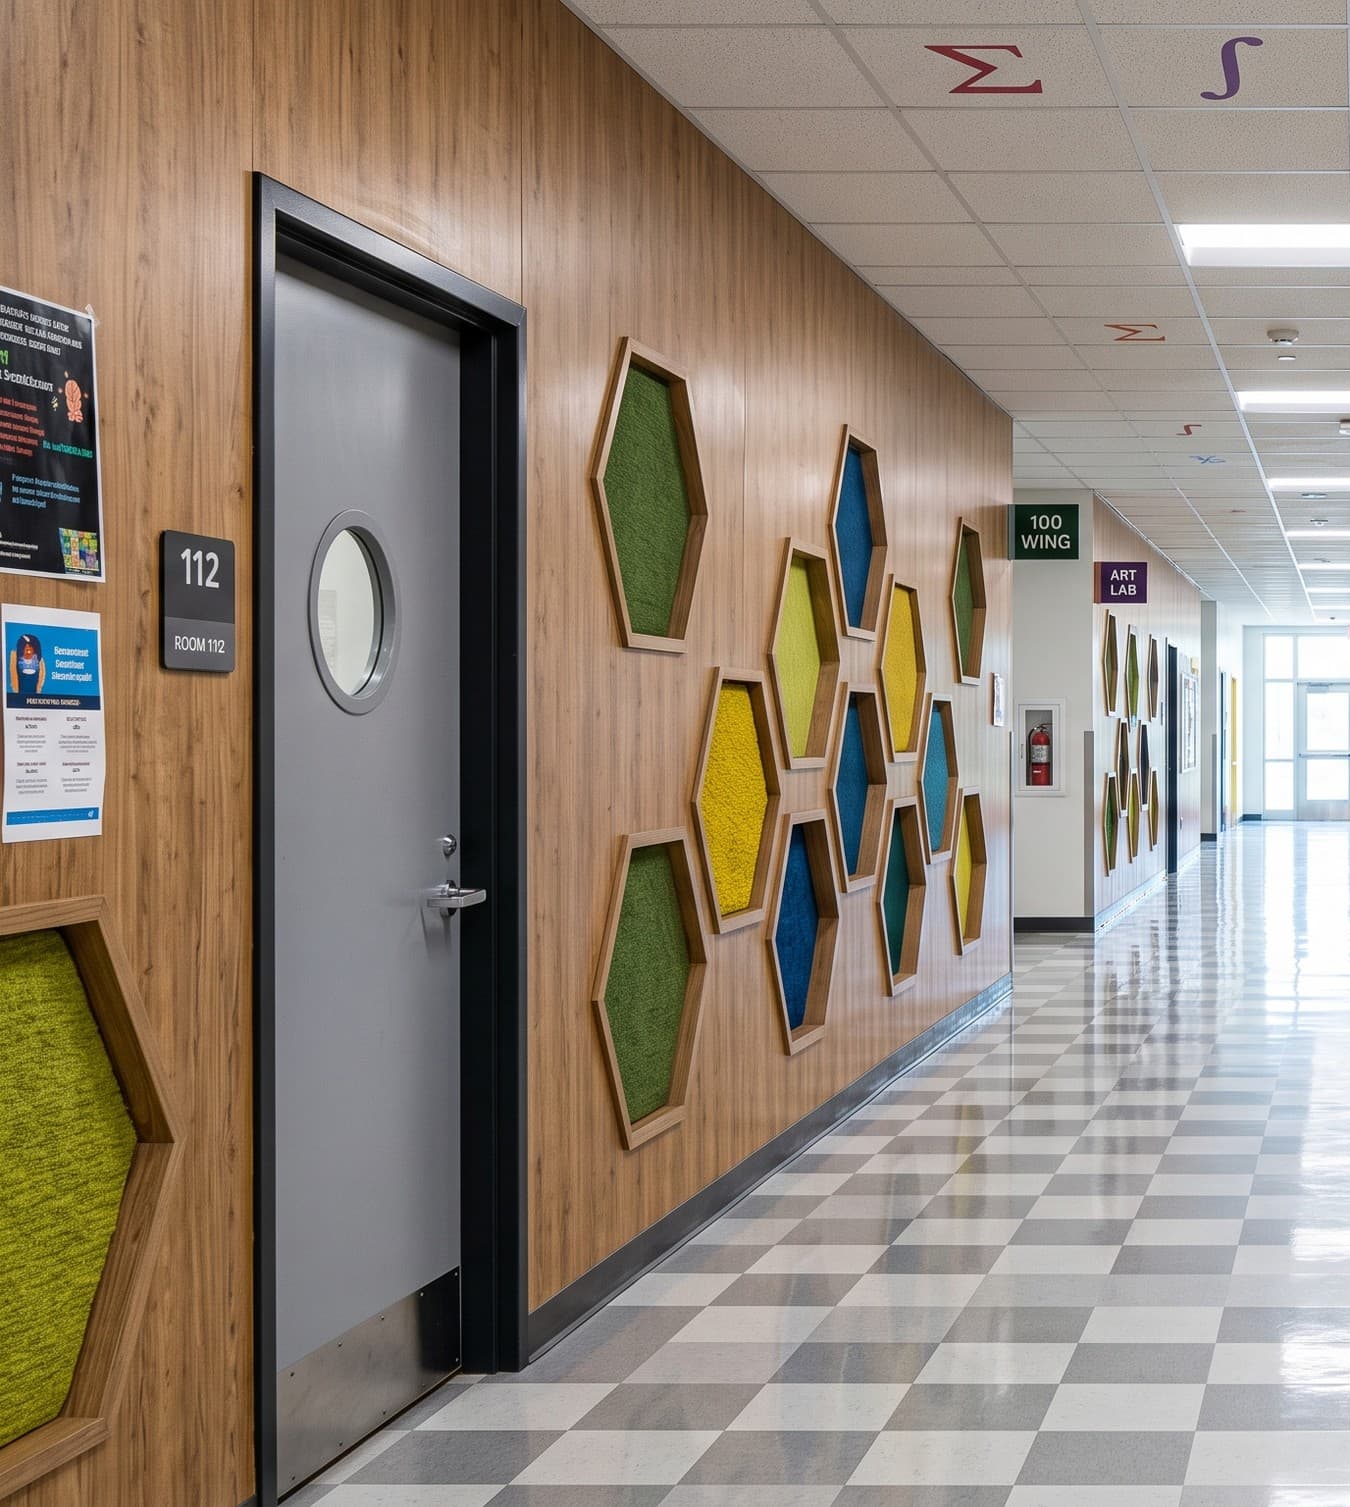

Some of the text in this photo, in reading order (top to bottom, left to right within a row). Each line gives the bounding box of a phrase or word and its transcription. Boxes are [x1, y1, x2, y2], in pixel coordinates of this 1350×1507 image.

[1029, 514, 1062, 530] 100
[1021, 534, 1071, 549] WING
[180, 548, 220, 589] 112
[1110, 569, 1137, 581] ART
[1110, 584, 1137, 596] LAB
[174, 635, 225, 654] ROOM 112
